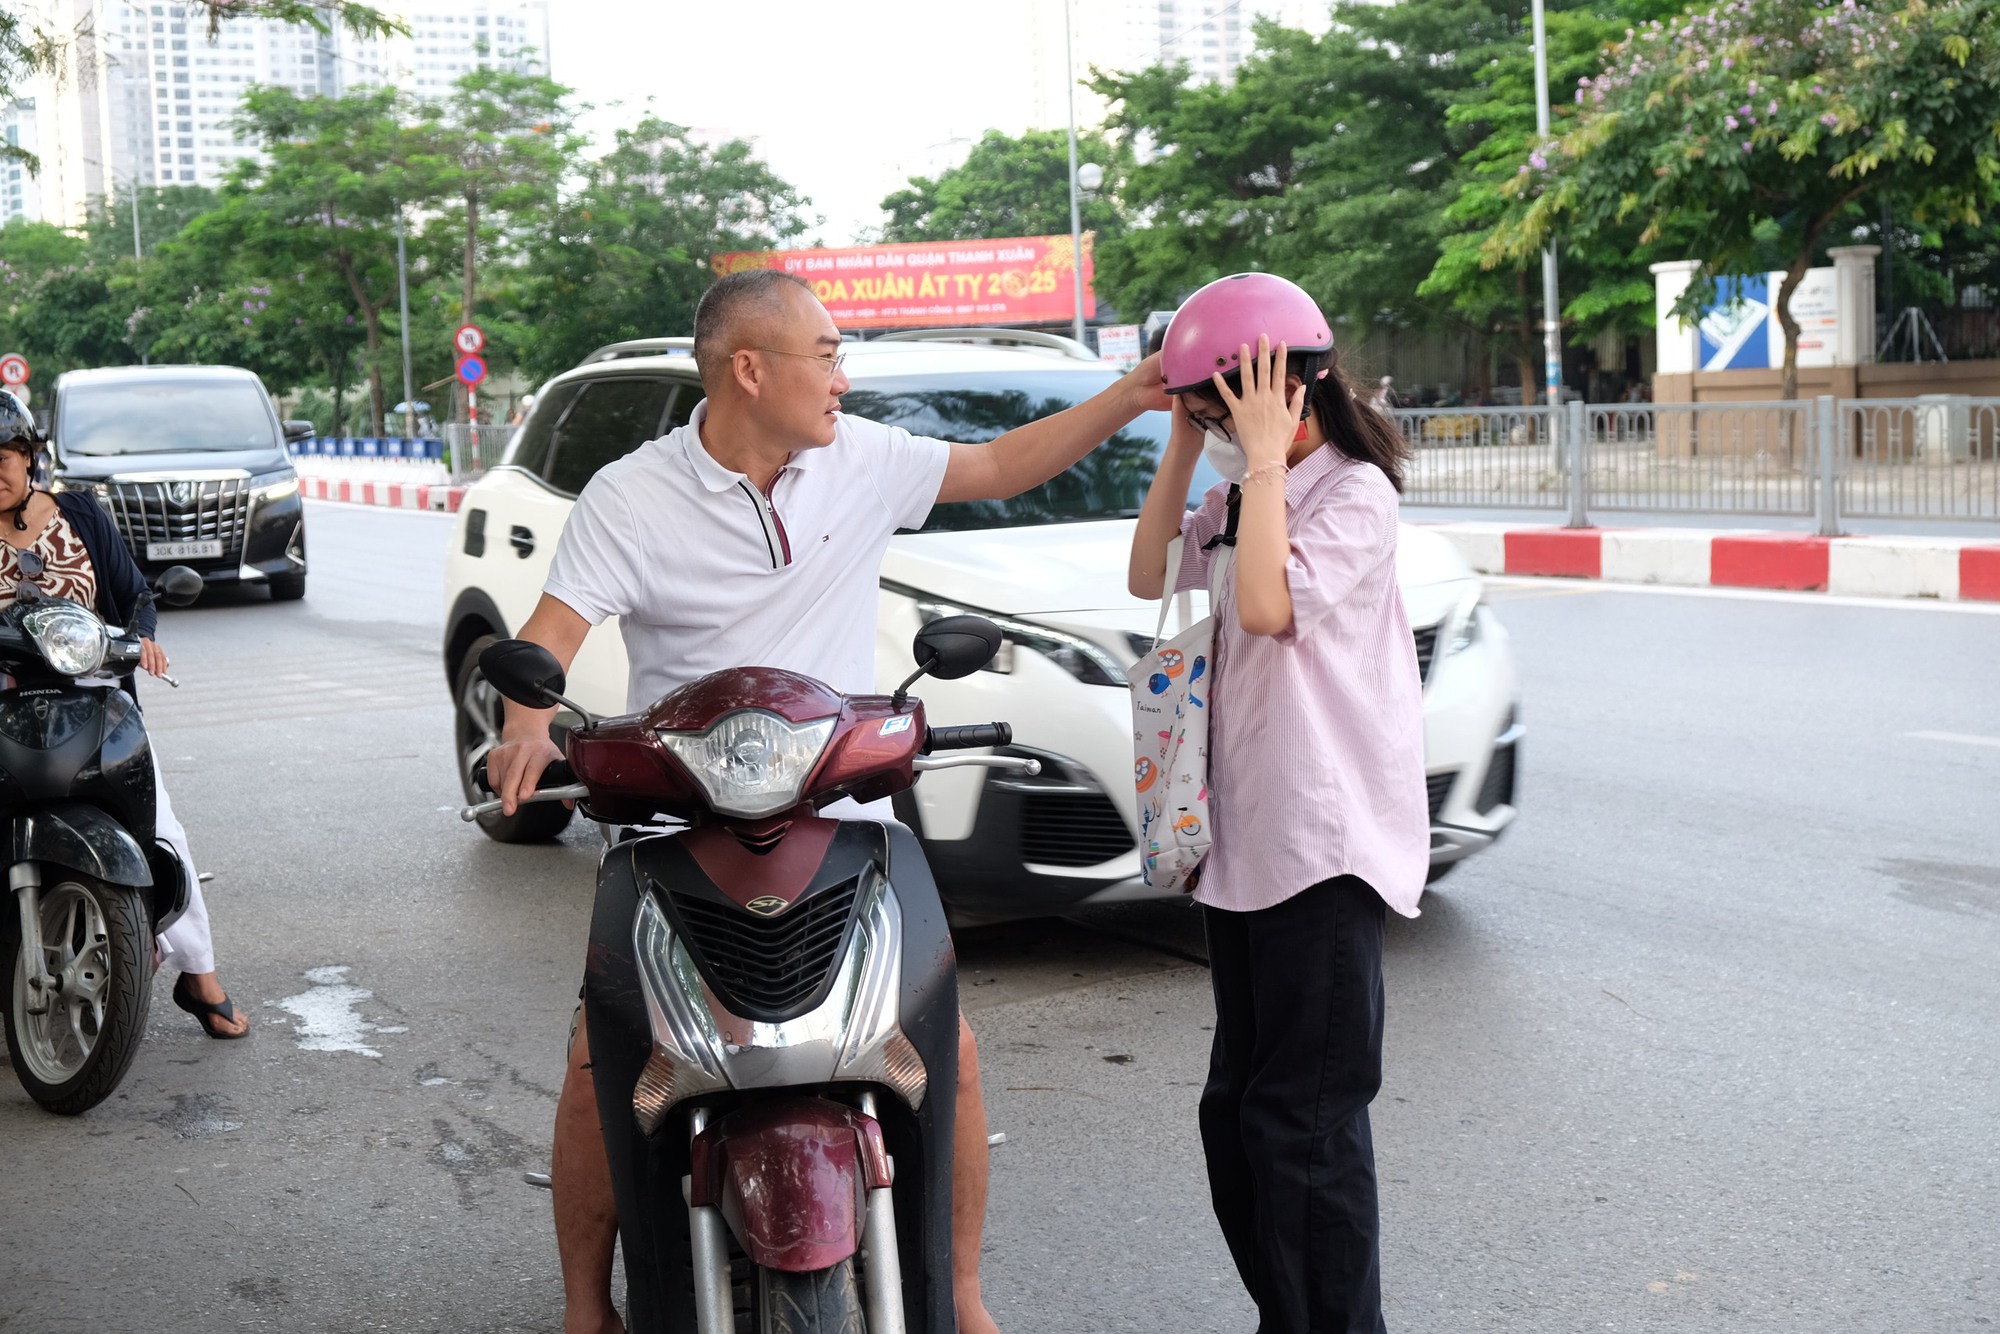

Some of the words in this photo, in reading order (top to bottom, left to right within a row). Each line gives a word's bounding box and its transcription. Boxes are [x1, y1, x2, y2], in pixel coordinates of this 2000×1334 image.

[806, 257, 833, 270] BAN
[836, 253, 873, 268] NHÂN
[876, 251, 904, 266] DÂN
[907, 252, 945, 268] QUẬN
[948, 249, 994, 264] THANH
[997, 246, 1034, 260] XUÂN
[851, 271, 914, 300] XUÂN
[19, 689, 63, 697] HONDA
[1136, 700, 1162, 714] Taiwan
